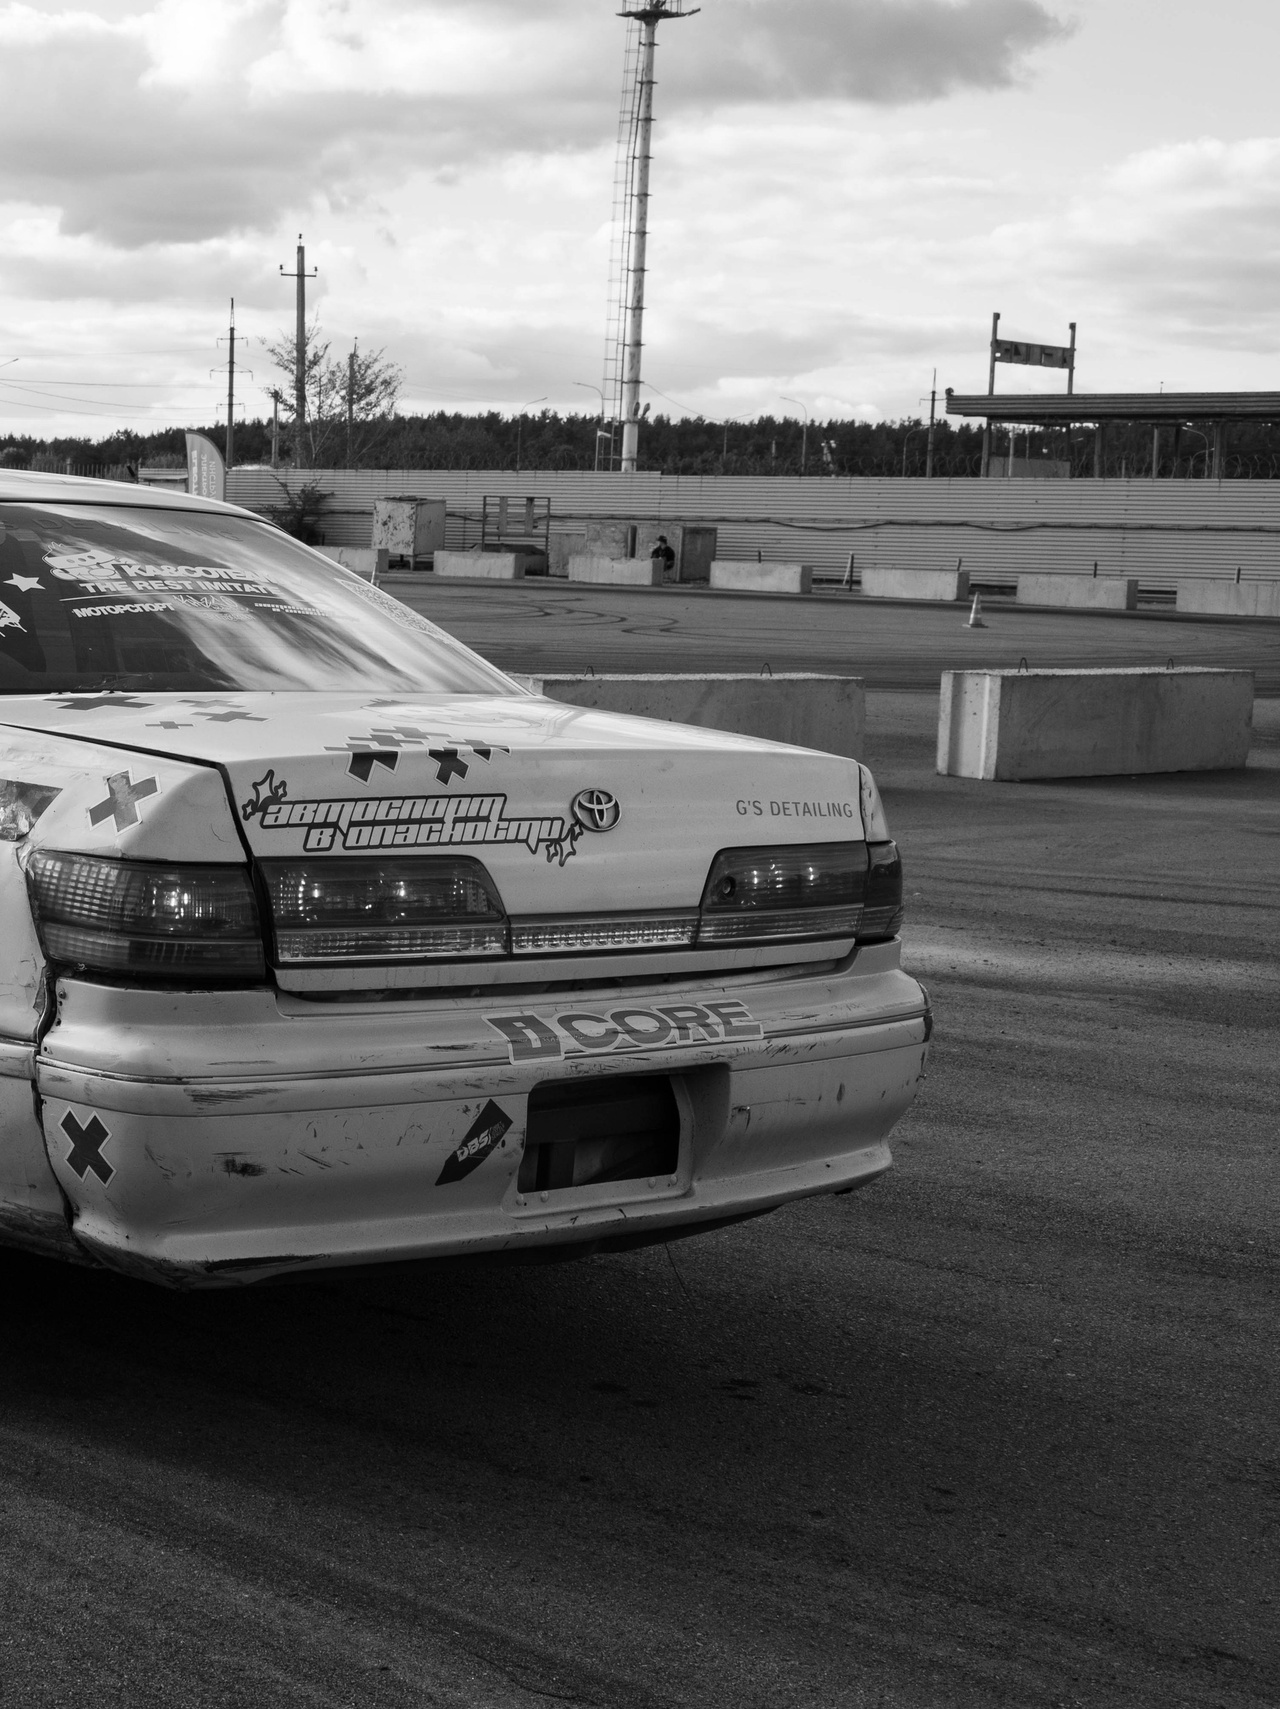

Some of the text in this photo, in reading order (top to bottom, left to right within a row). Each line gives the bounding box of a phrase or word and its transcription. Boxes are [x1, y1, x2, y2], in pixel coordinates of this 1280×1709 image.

[80, 580, 282, 595] THE REST IMITATE
[73, 602, 175, 618] МОТОРСПОРТ
[736, 799, 853, 818] G'S DETAILING
[456, 1128, 490, 1162] DBS
